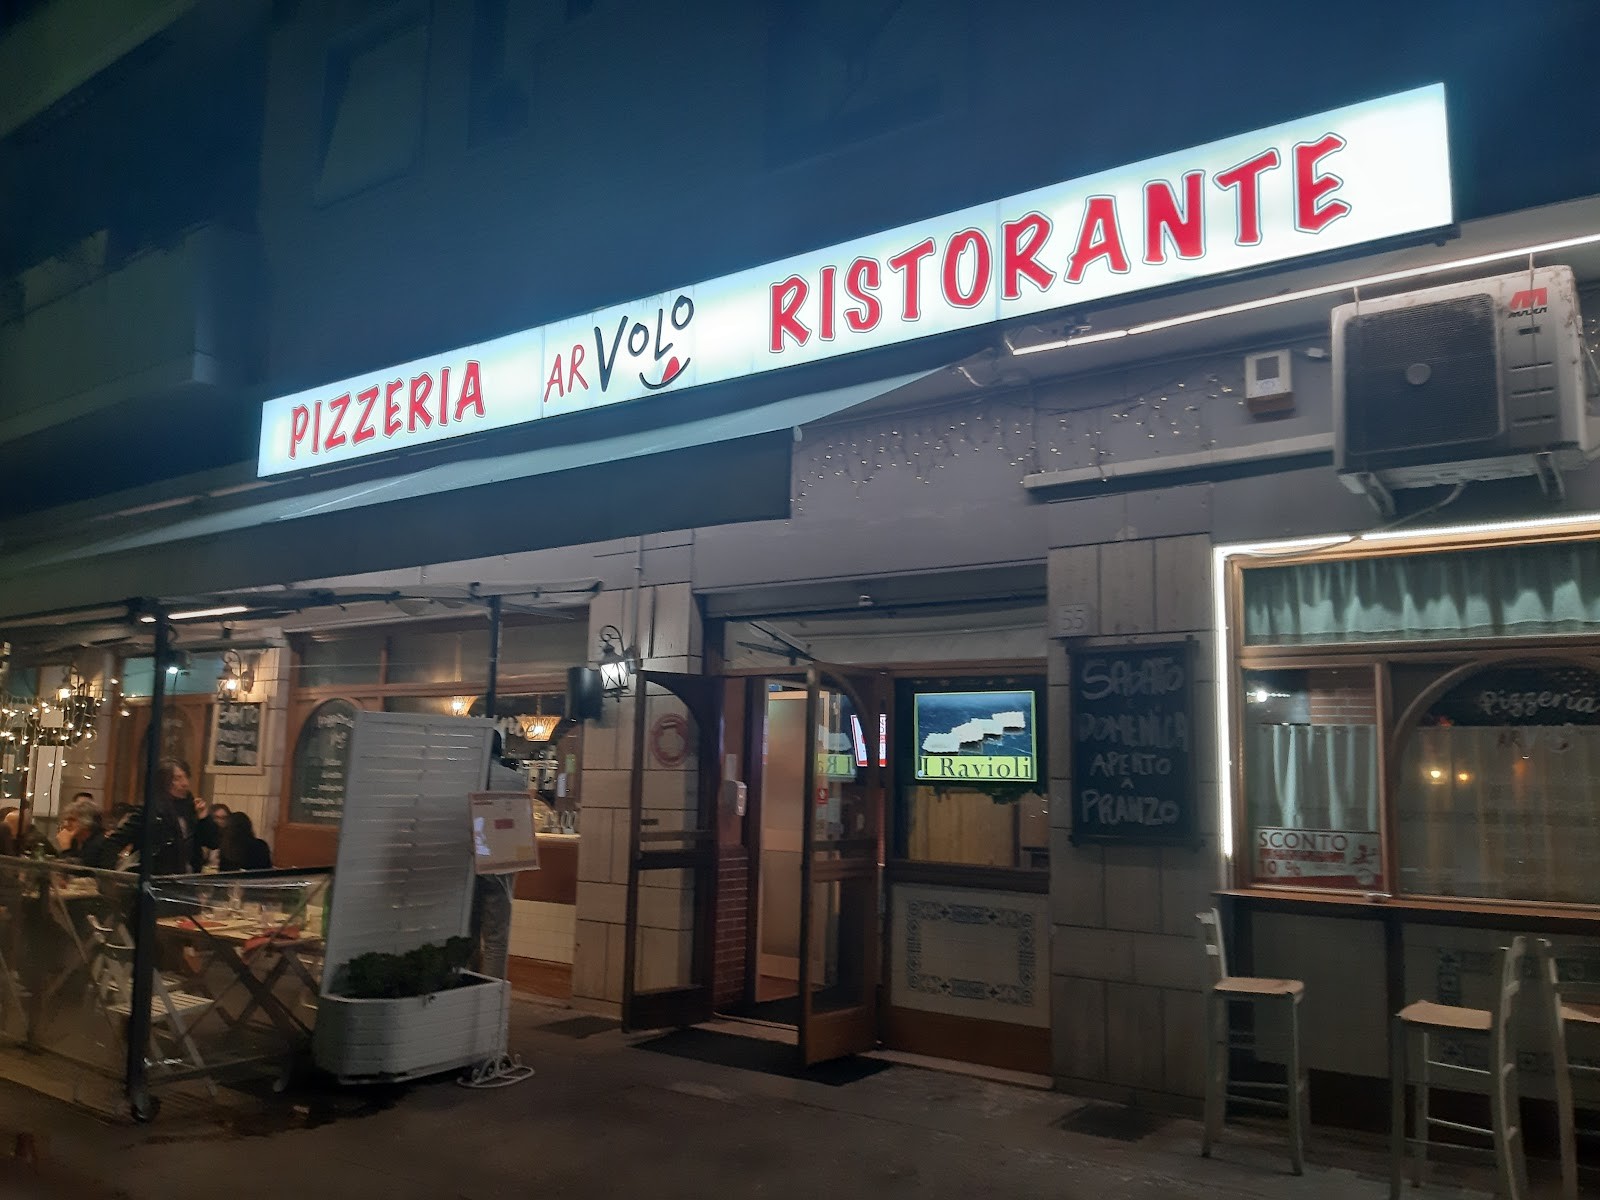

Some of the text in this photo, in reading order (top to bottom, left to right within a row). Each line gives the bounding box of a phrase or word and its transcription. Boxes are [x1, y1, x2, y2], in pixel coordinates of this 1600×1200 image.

[768, 132, 1353, 354] RISTORANTE
[543, 344, 589, 403] AR
[288, 359, 486, 460] PIZZERIA
[1059, 608, 1085, 630] 55
[939, 756, 1031, 779] Ravioli
[1089, 751, 1172, 777] APERTO
[1080, 788, 1180, 827] PRANZO
[1258, 830, 1348, 851] SCONTO
